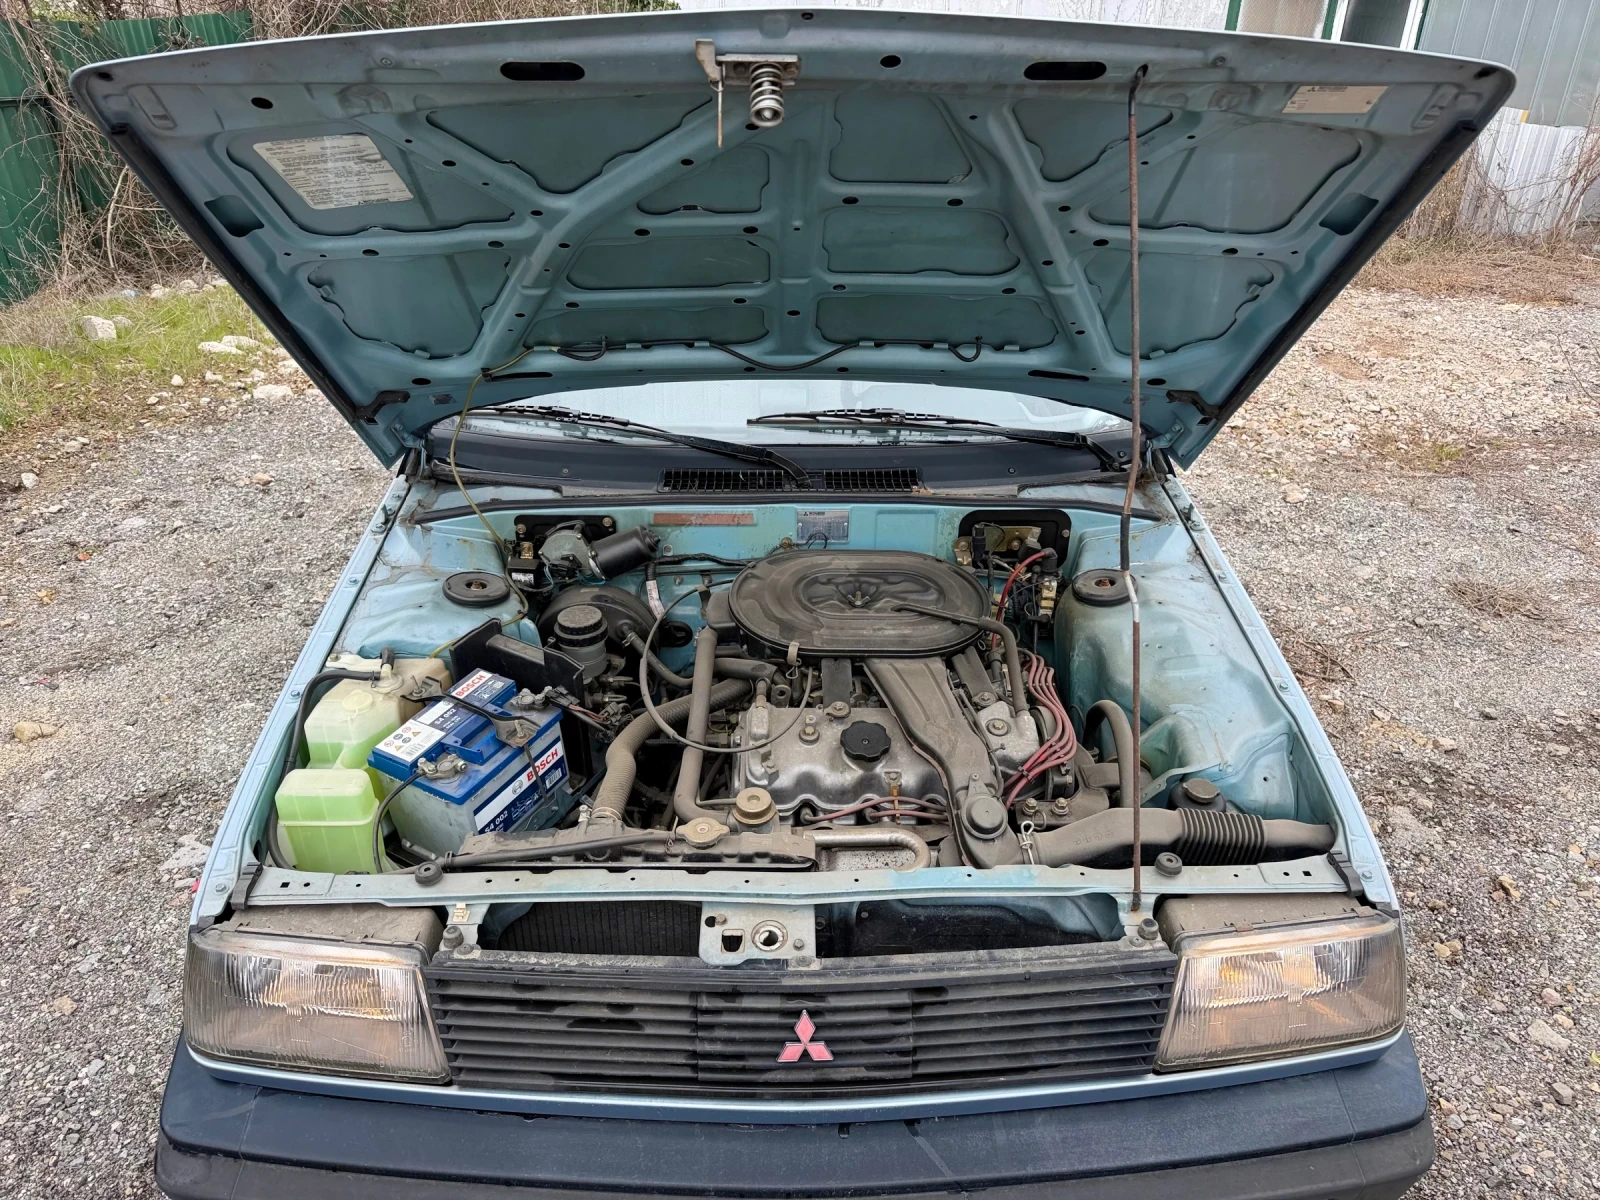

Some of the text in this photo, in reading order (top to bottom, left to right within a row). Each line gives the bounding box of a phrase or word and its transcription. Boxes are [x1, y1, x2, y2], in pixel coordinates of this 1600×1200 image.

[455, 674, 486, 697] BOSCH
[526, 748, 559, 782] BOSCH
[484, 822, 495, 833] S4
[495, 810, 508, 825] 002
